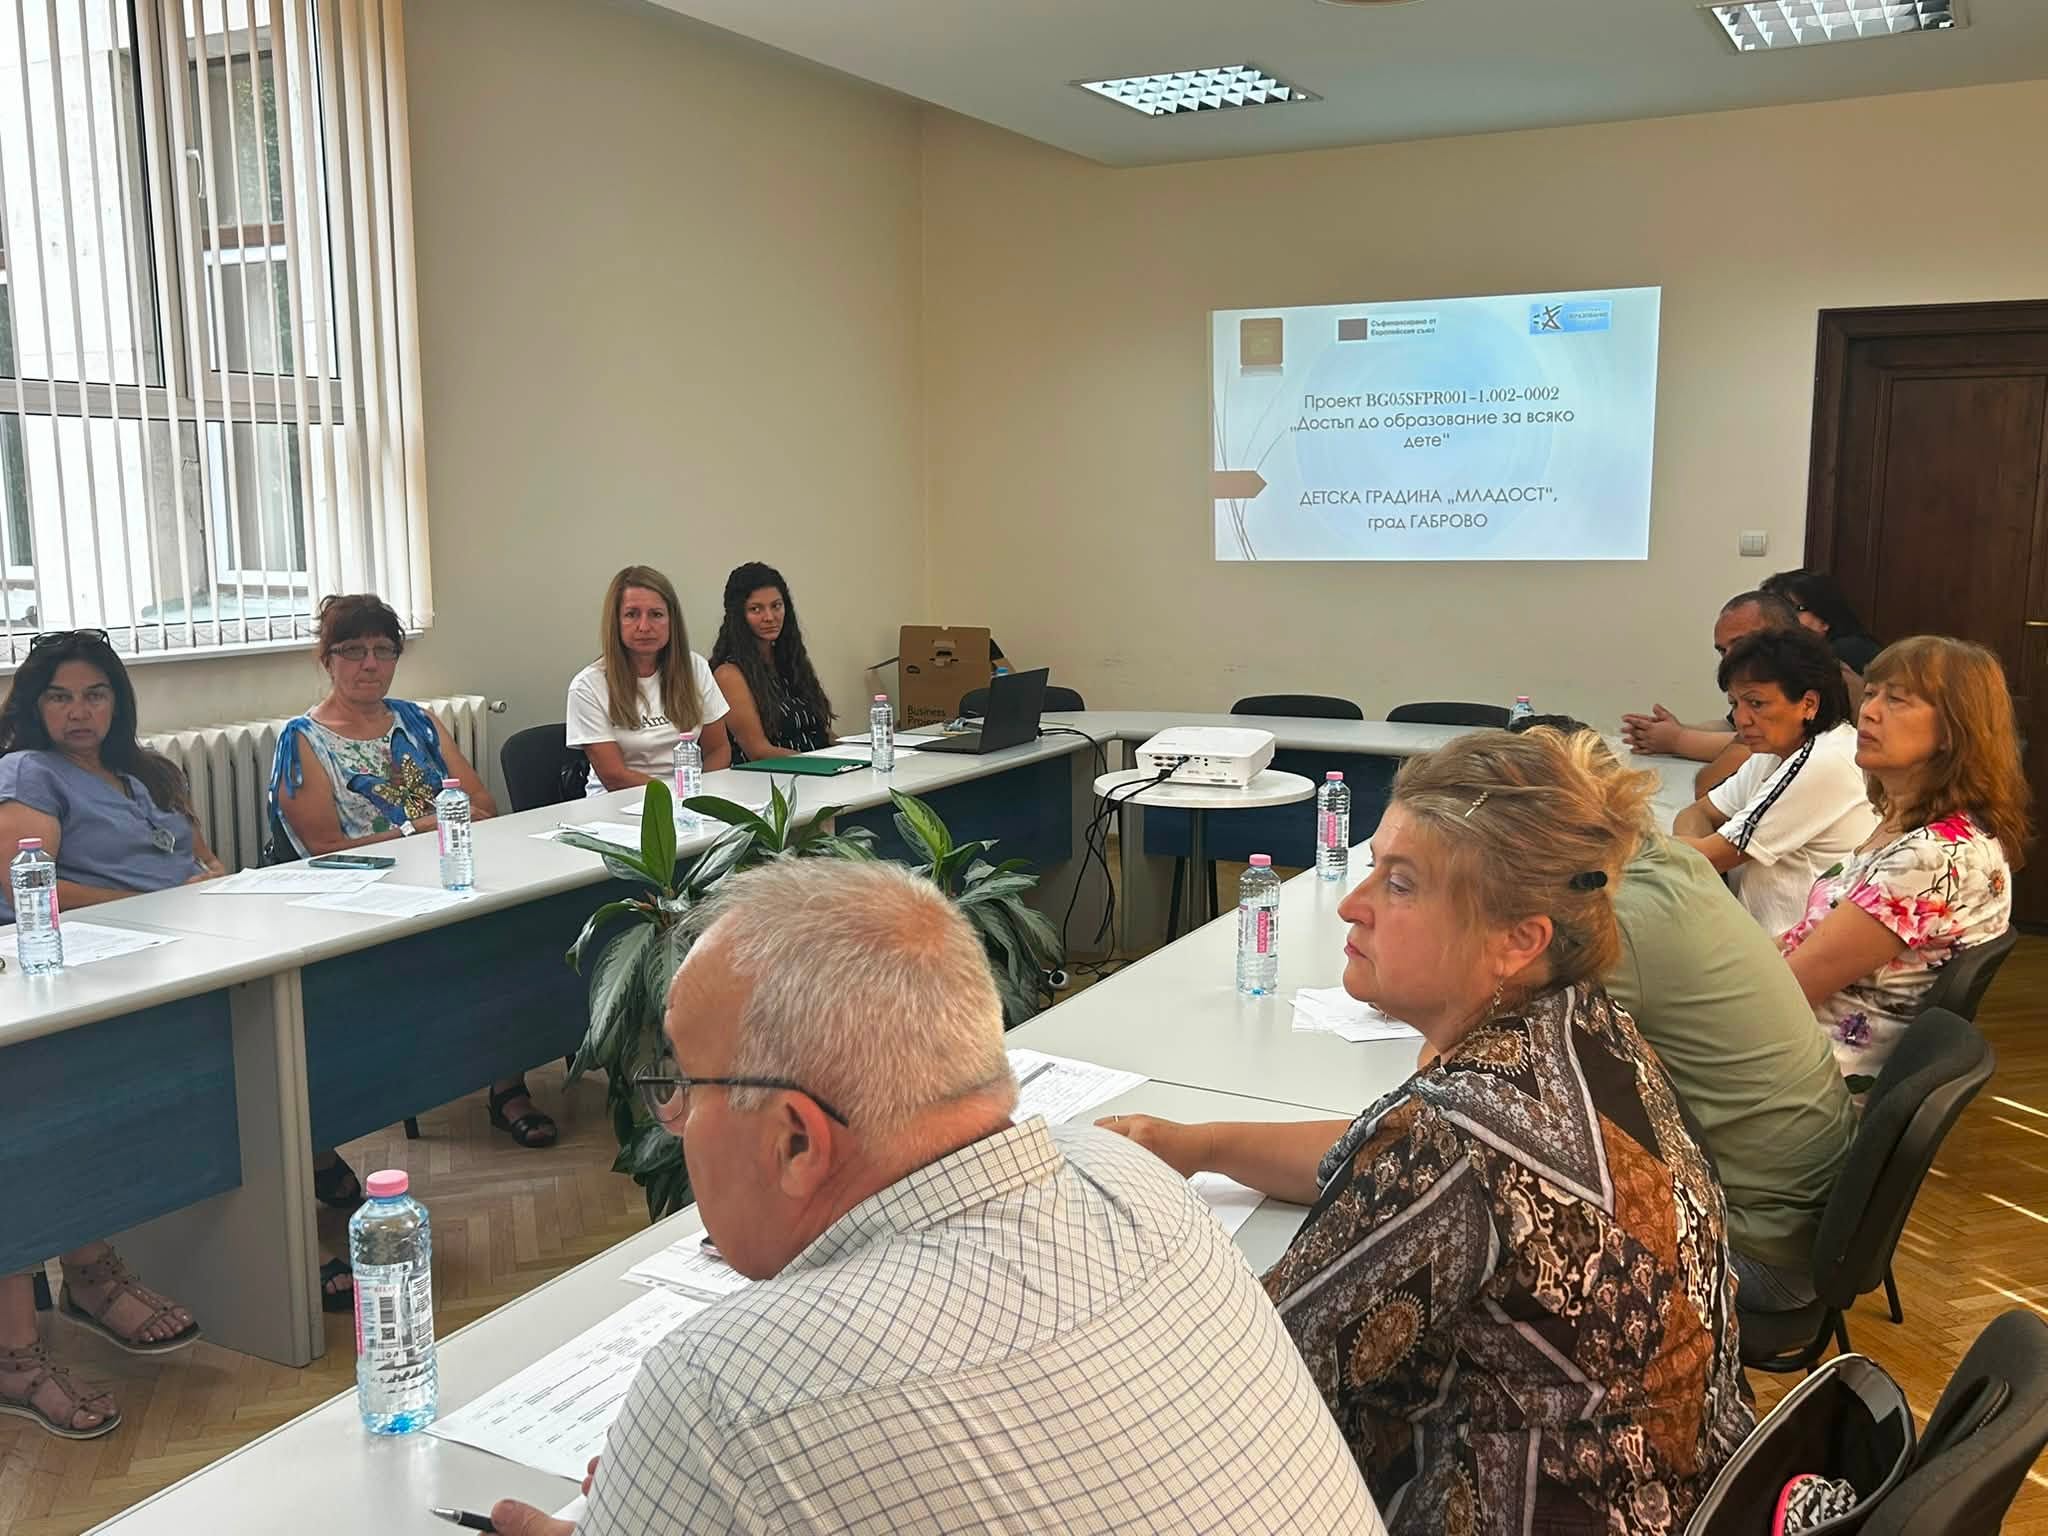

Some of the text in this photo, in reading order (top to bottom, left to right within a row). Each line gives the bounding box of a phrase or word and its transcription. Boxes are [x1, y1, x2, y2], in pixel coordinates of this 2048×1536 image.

[1304, 386, 1560, 412] Проект BG05SFPR001-1.002-0002
[1358, 416, 1379, 430] до
[1383, 411, 1498, 429] образование
[1502, 411, 1521, 424] за
[1527, 410, 1575, 424] всяко
[1300, 490, 1361, 506] ДЕТСКА
[1366, 489, 1442, 505] ГРАДИНА
[1368, 513, 1488, 533] град ГАБРОВО
